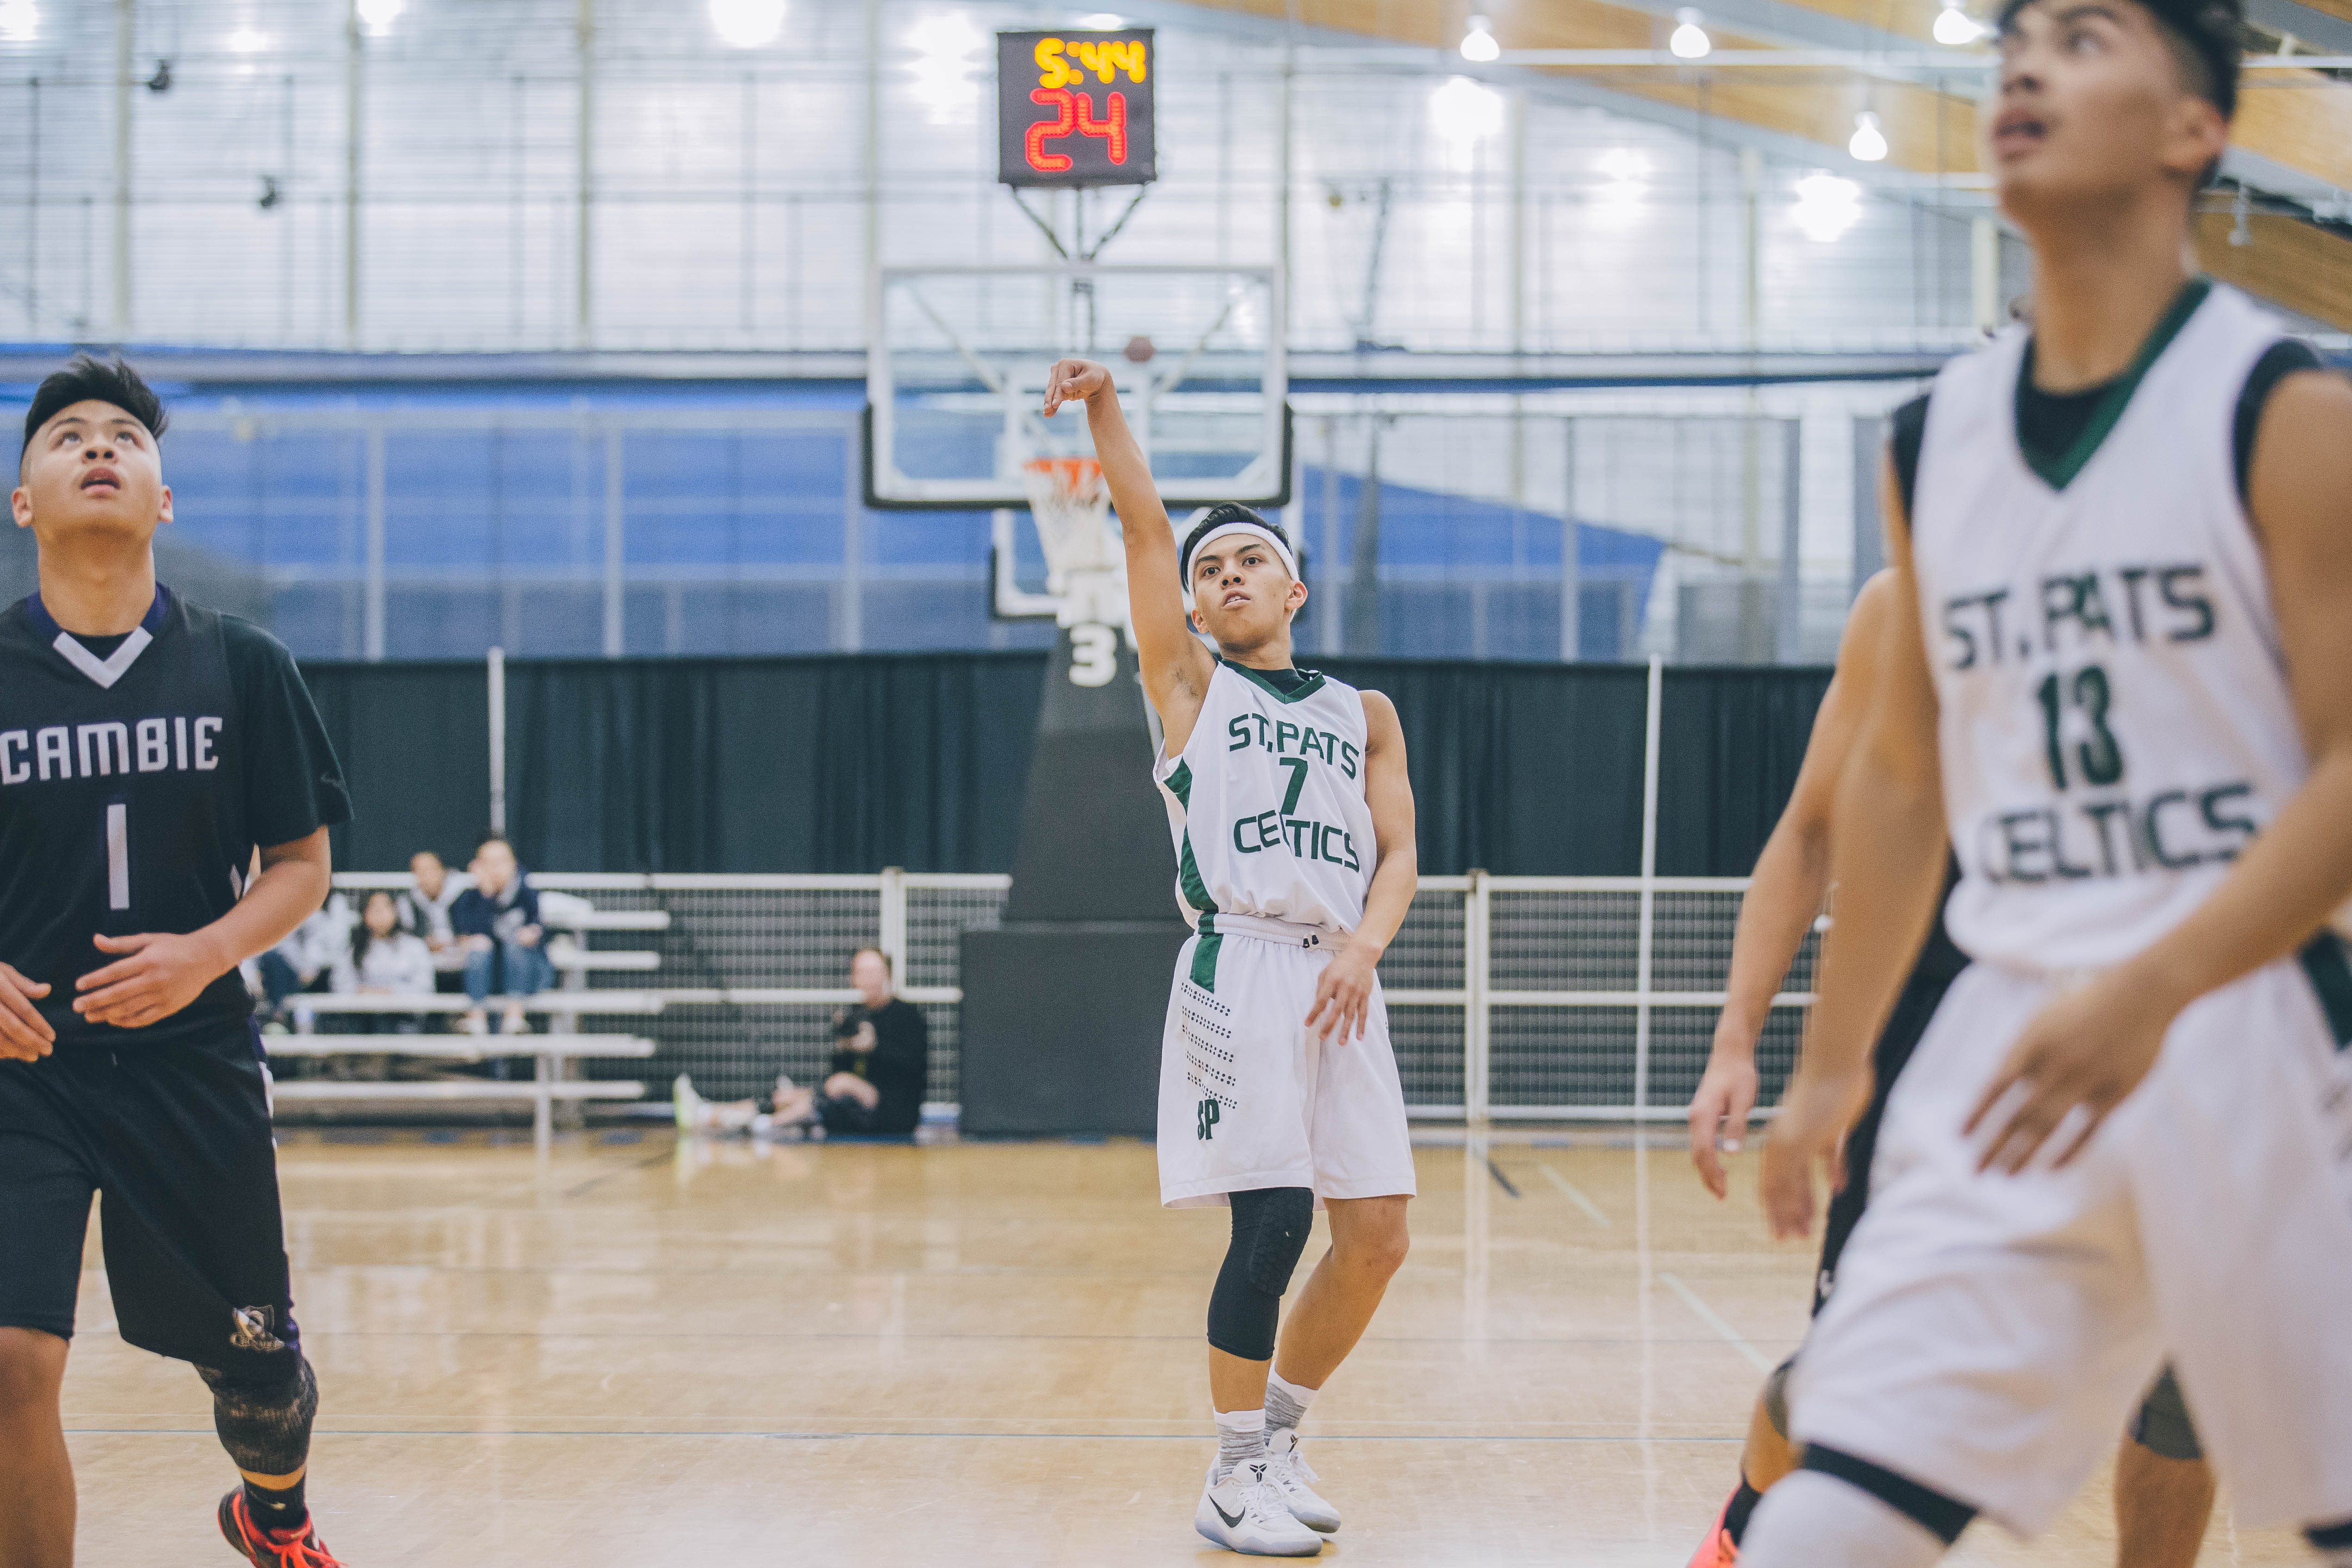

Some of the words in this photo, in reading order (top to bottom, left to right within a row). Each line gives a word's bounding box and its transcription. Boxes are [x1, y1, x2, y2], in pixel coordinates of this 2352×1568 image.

[1034, 38, 1146, 88] 5:44
[1025, 88, 1127, 171] 24
[1068, 625, 1117, 687] 3
[0, 717, 223, 785] CAMBIE
[2037, 665, 2124, 790] 13
[1279, 757, 1308, 816] 7
[107, 804, 129, 910] 1
[1233, 809, 1360, 873] CETICS
